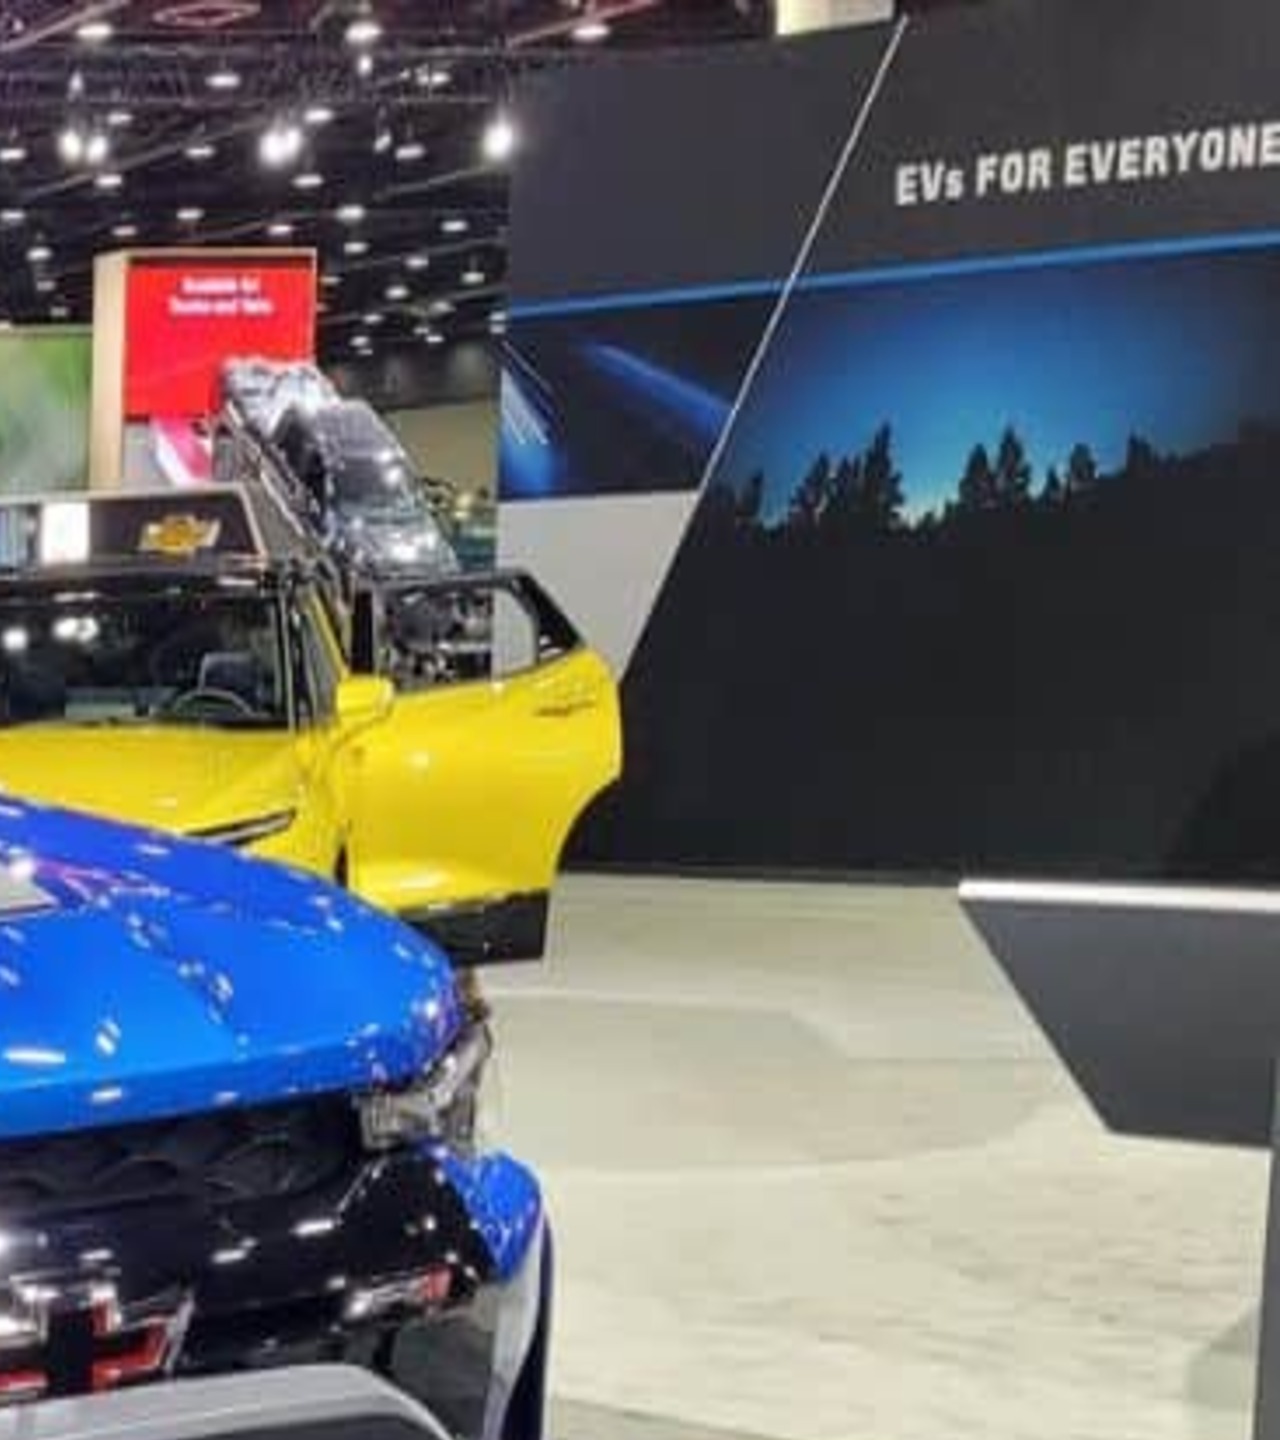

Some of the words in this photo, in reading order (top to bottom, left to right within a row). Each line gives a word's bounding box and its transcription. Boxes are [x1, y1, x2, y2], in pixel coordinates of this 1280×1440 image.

[896, 161, 964, 206] EVs
[976, 149, 1051, 197] FOR
[1063, 122, 1280, 186] EVERYONE
